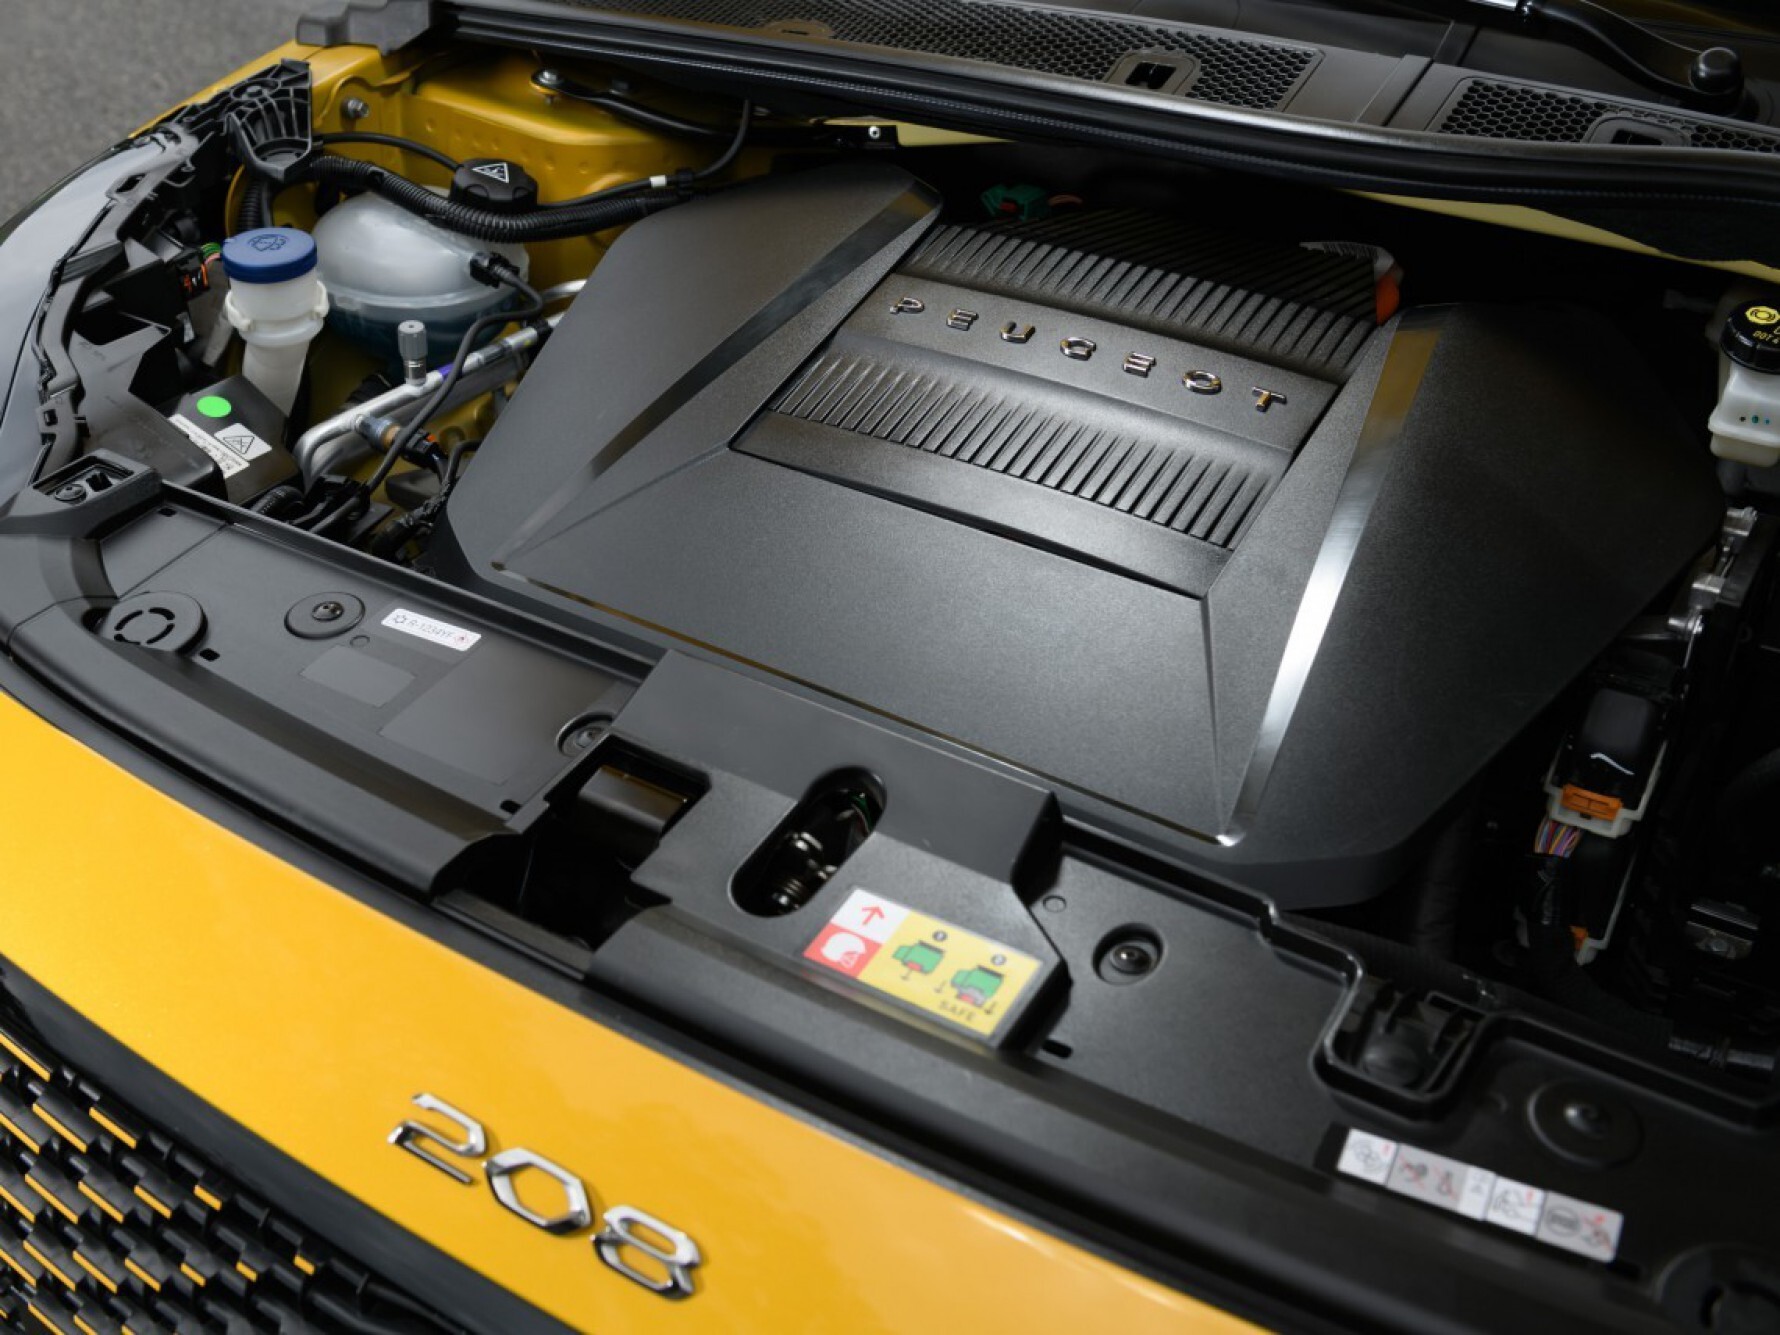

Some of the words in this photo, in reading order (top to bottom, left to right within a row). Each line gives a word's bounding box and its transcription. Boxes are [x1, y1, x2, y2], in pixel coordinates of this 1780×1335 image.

[889, 296, 1288, 412] PEUGEOT
[938, 999, 976, 1021] SAFE
[387, 1092, 701, 1299] 208
